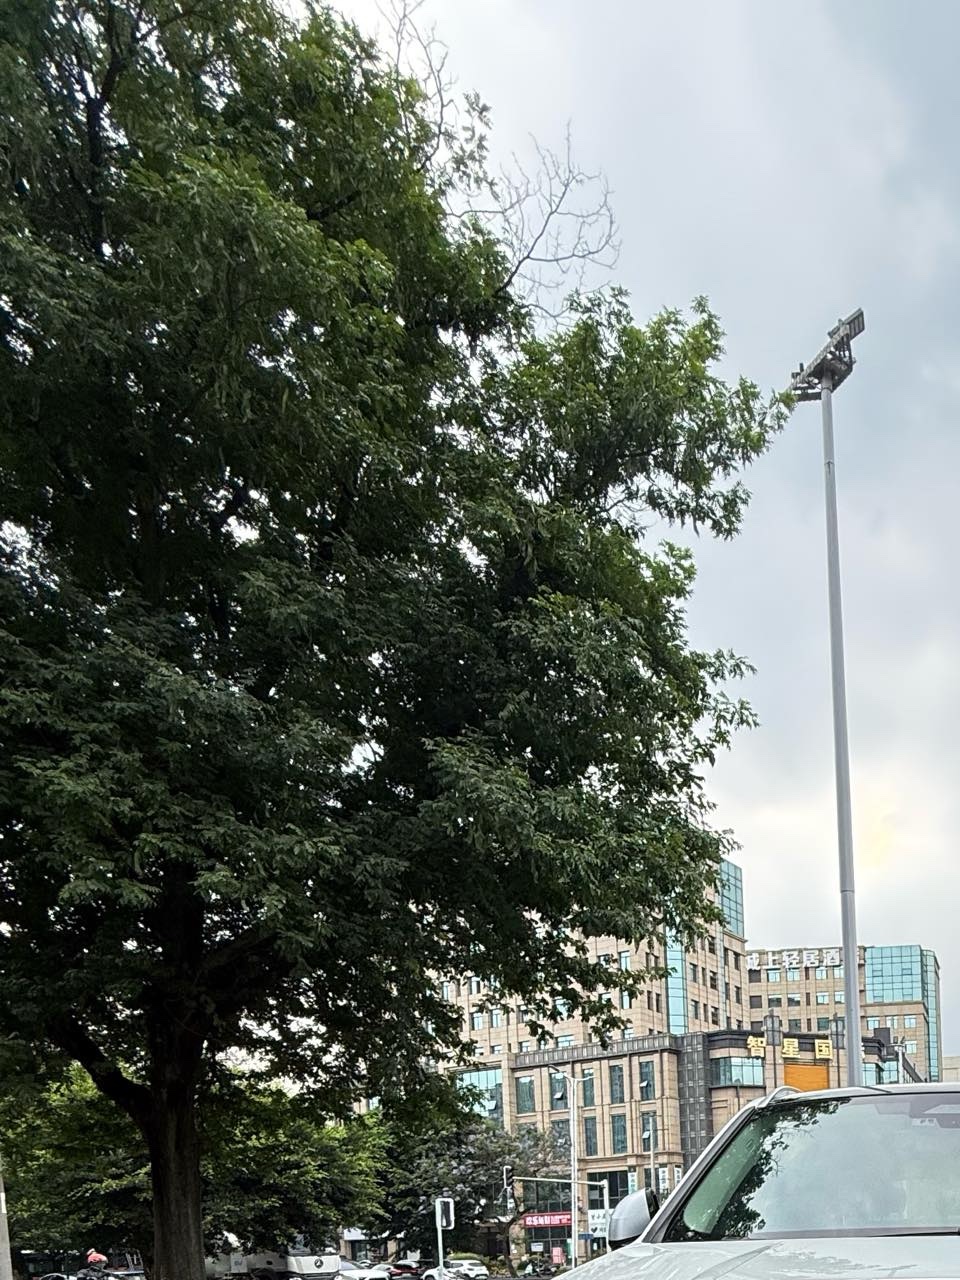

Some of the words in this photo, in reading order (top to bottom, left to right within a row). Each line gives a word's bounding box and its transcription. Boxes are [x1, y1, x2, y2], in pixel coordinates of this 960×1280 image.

[746, 948, 860, 971] 城上轻居酒
[747, 1035, 865, 1060] 智星国
